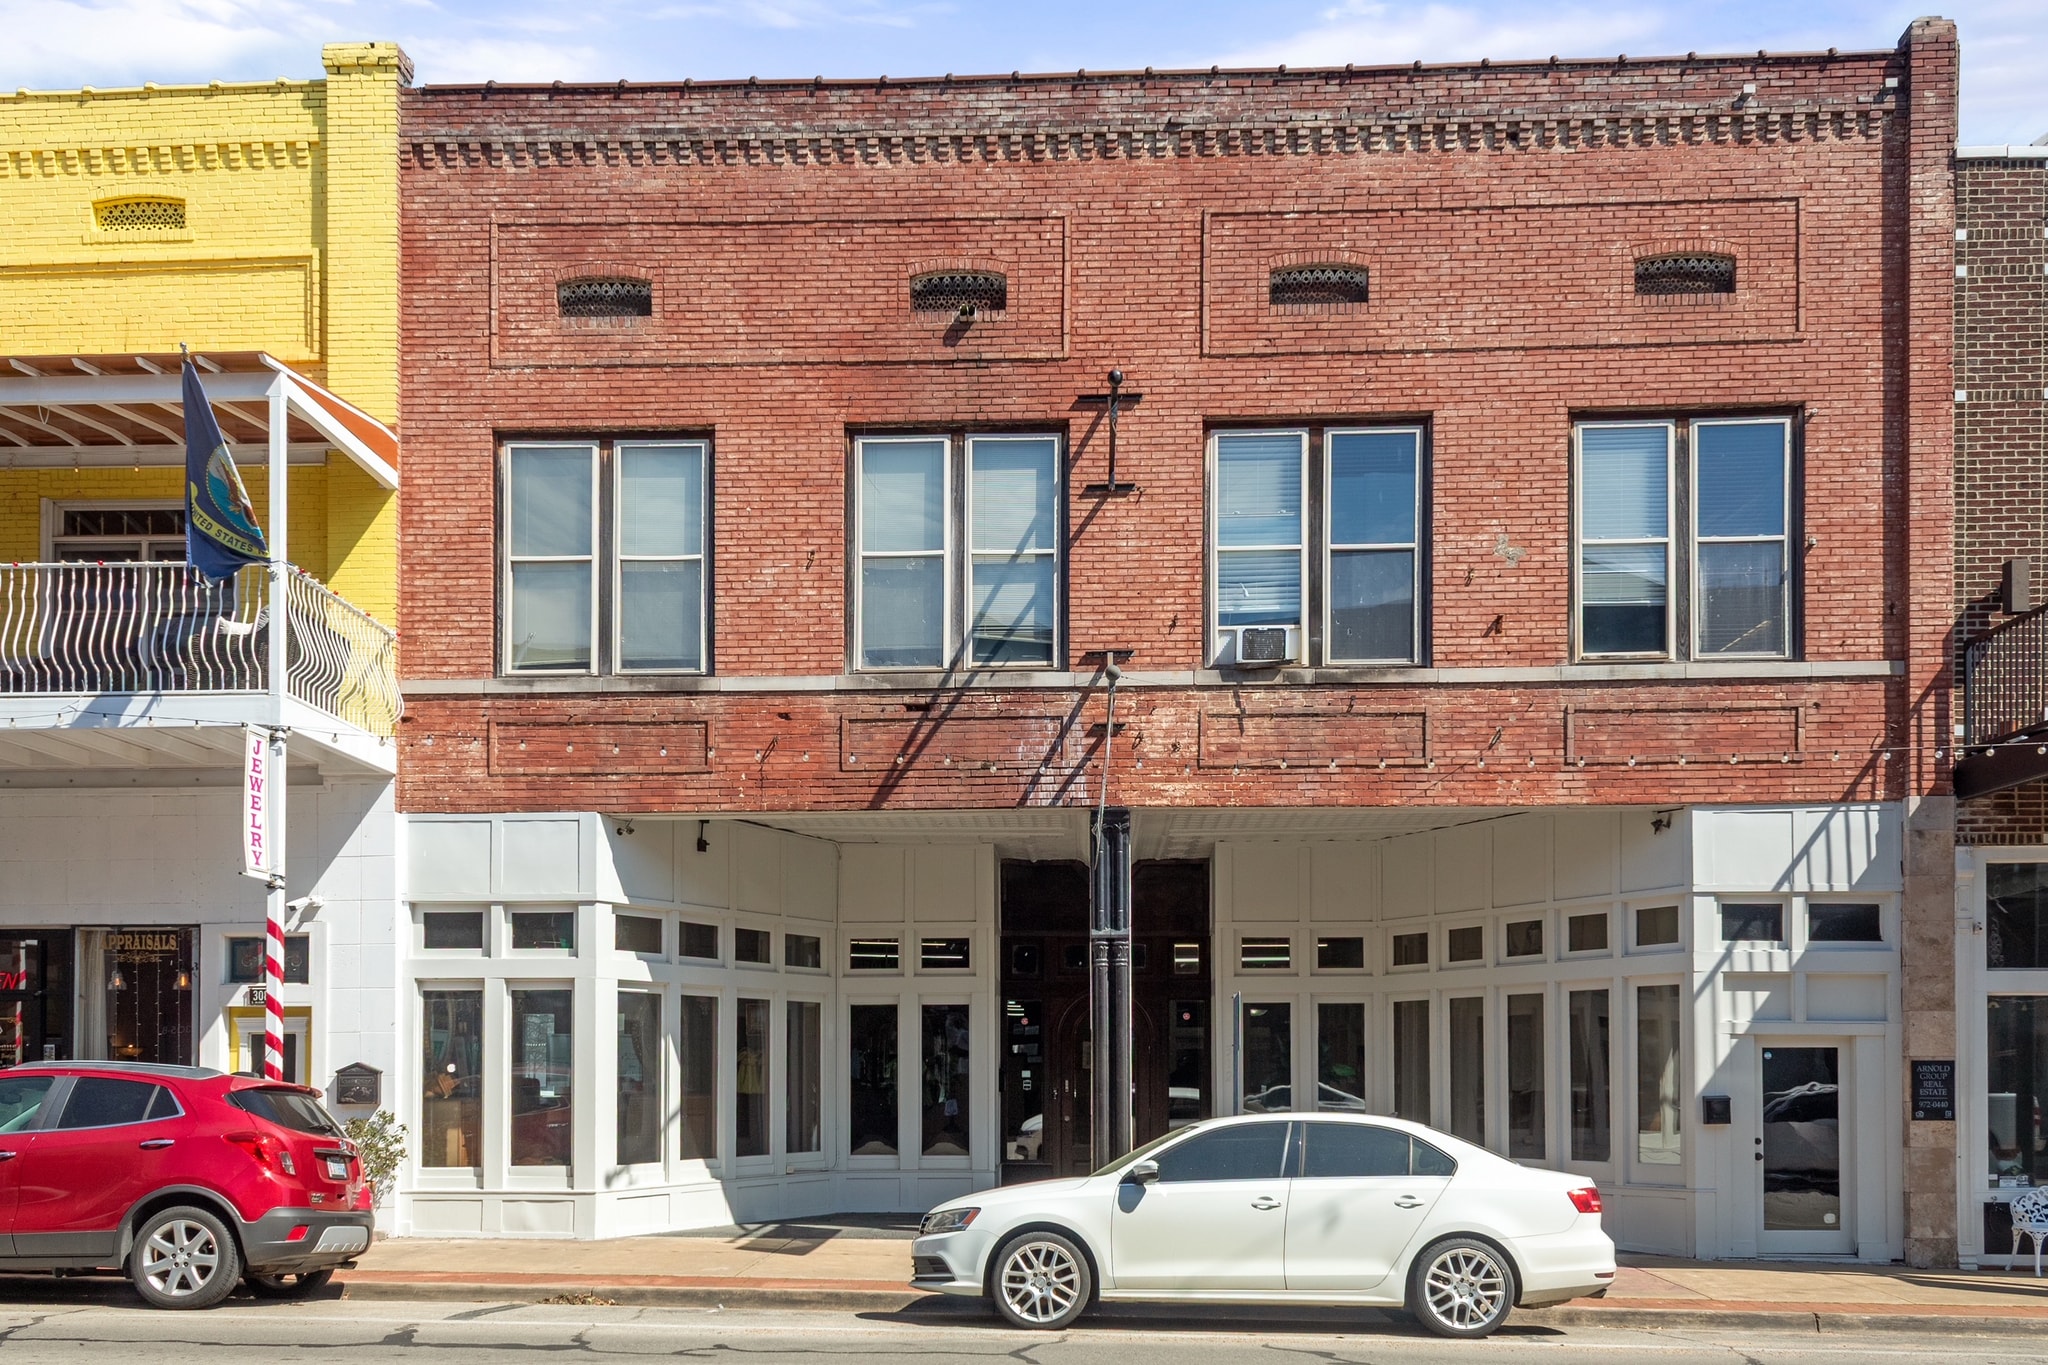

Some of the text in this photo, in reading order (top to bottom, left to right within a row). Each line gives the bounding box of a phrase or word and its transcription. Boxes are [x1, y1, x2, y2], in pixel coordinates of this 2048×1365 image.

[191, 502, 254, 553] NITED STATES
[249, 739, 264, 866] JEWELRY
[100, 934, 177, 950] APPRAISALS
[1920, 1072, 1948, 1080] GROUP
[1923, 1080, 1944, 1088] REAL
[1919, 1088, 1948, 1096] ESTATE
[1918, 1100, 1949, 1108] 972-0440
